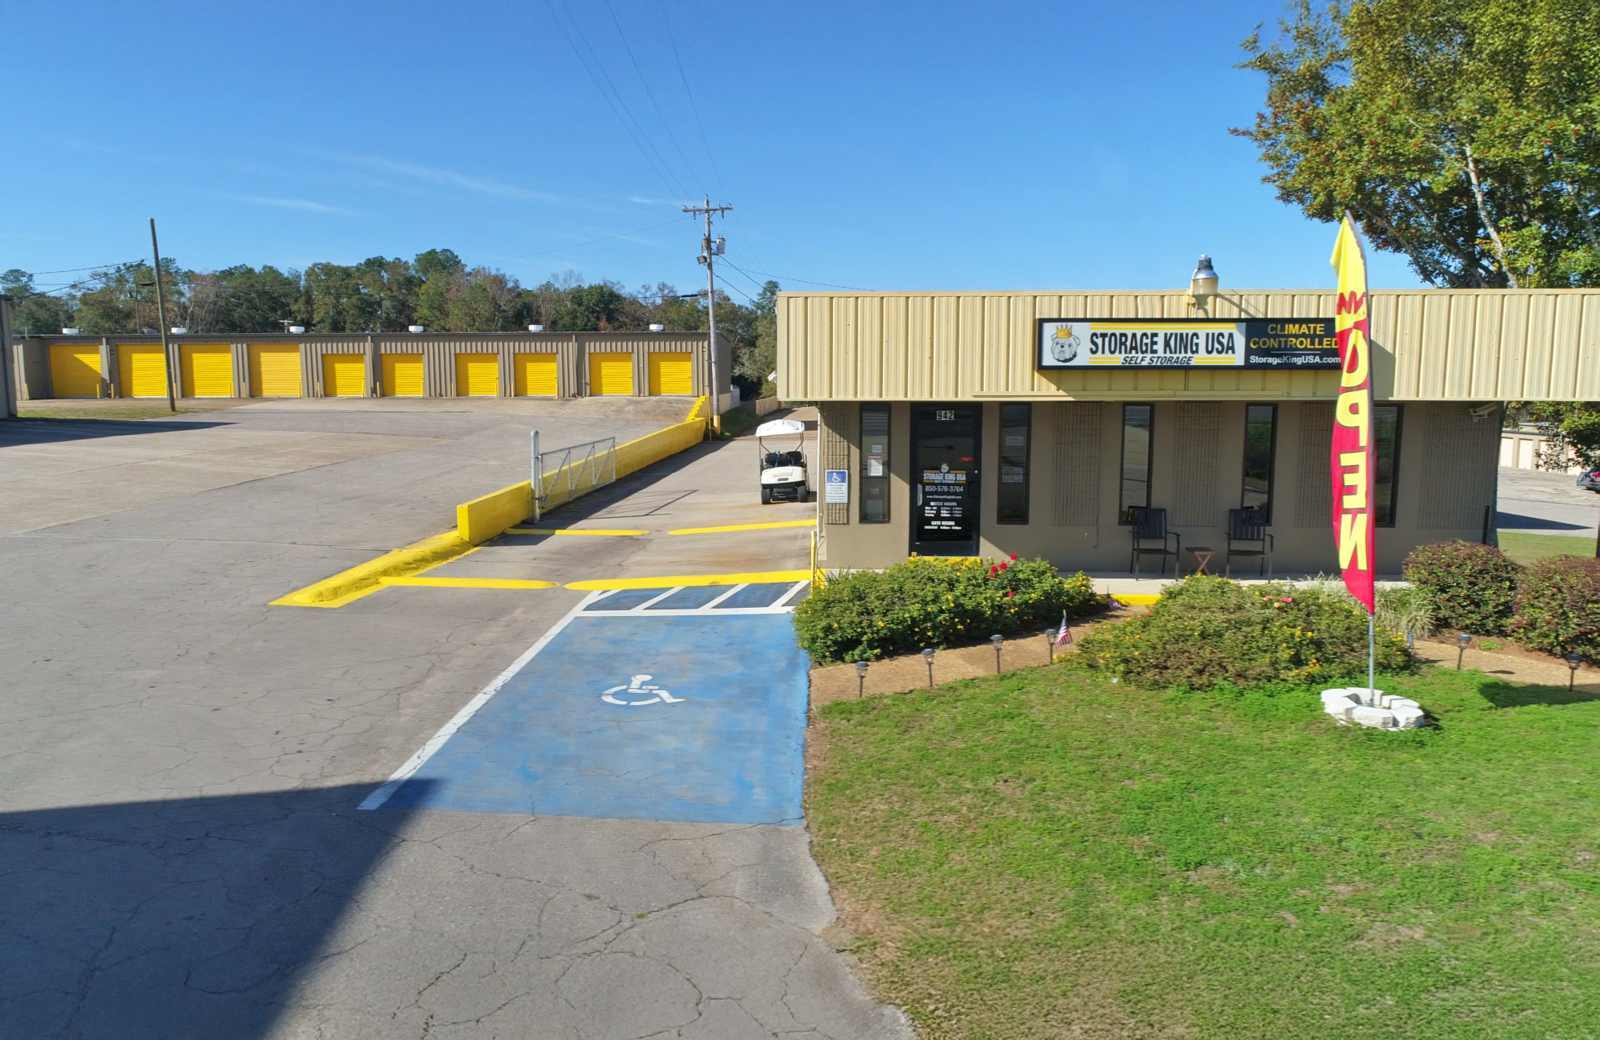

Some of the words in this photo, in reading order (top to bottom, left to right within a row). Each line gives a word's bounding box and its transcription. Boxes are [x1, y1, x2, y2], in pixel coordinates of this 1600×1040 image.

[1267, 323, 1326, 335] CLIMATE
[1089, 332, 1159, 354] STORAGE
[1163, 332, 1200, 354] KING
[1205, 332, 1236, 354] USA
[1121, 356, 1147, 365] SELF
[1148, 356, 1194, 365] STORAGE
[1249, 355, 1342, 365] StorageKingUSA.com
